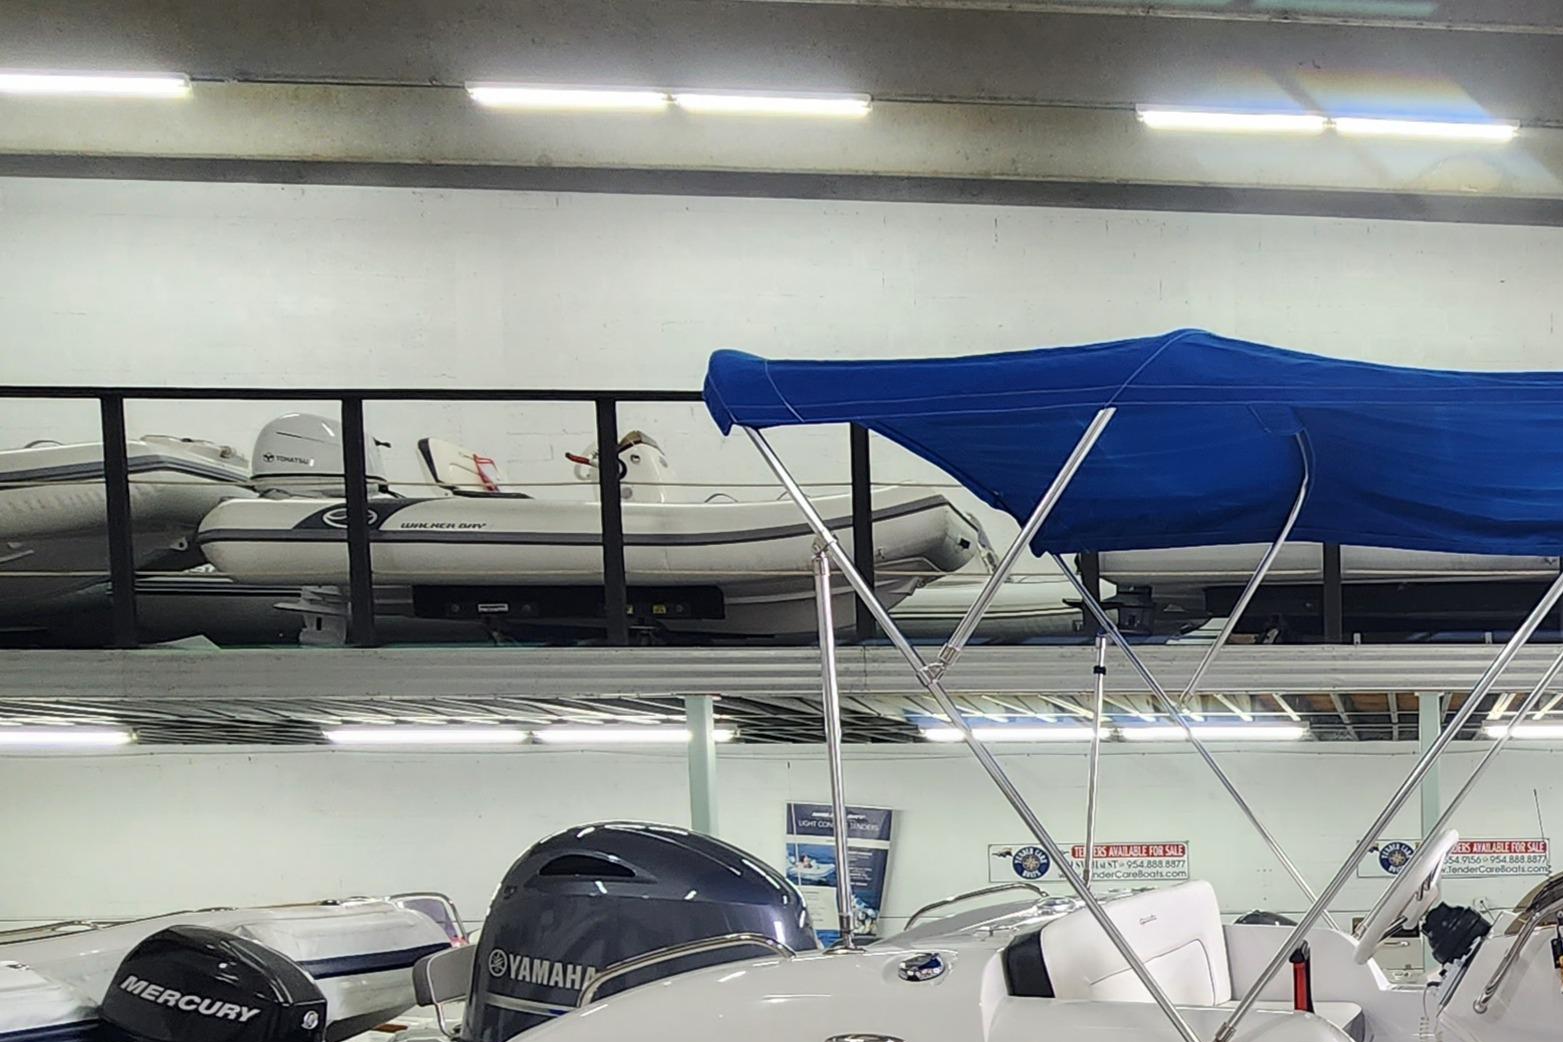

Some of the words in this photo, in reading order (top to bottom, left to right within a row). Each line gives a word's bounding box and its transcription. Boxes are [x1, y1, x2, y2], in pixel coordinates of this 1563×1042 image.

[1074, 846, 1107, 857] TEERS
[1108, 845, 1147, 857] AVAILABLE
[1149, 845, 1164, 856] FOR
[1165, 845, 1184, 856] SALE
[1472, 842, 1510, 853] AVAILABLE
[1511, 842, 1526, 852] FOR
[1527, 842, 1545, 852] SALE
[1489, 855, 1547, 864] 954.888.8877
[509, 953, 596, 990] YAMAHA
[120, 976, 260, 1022] MERCURY
